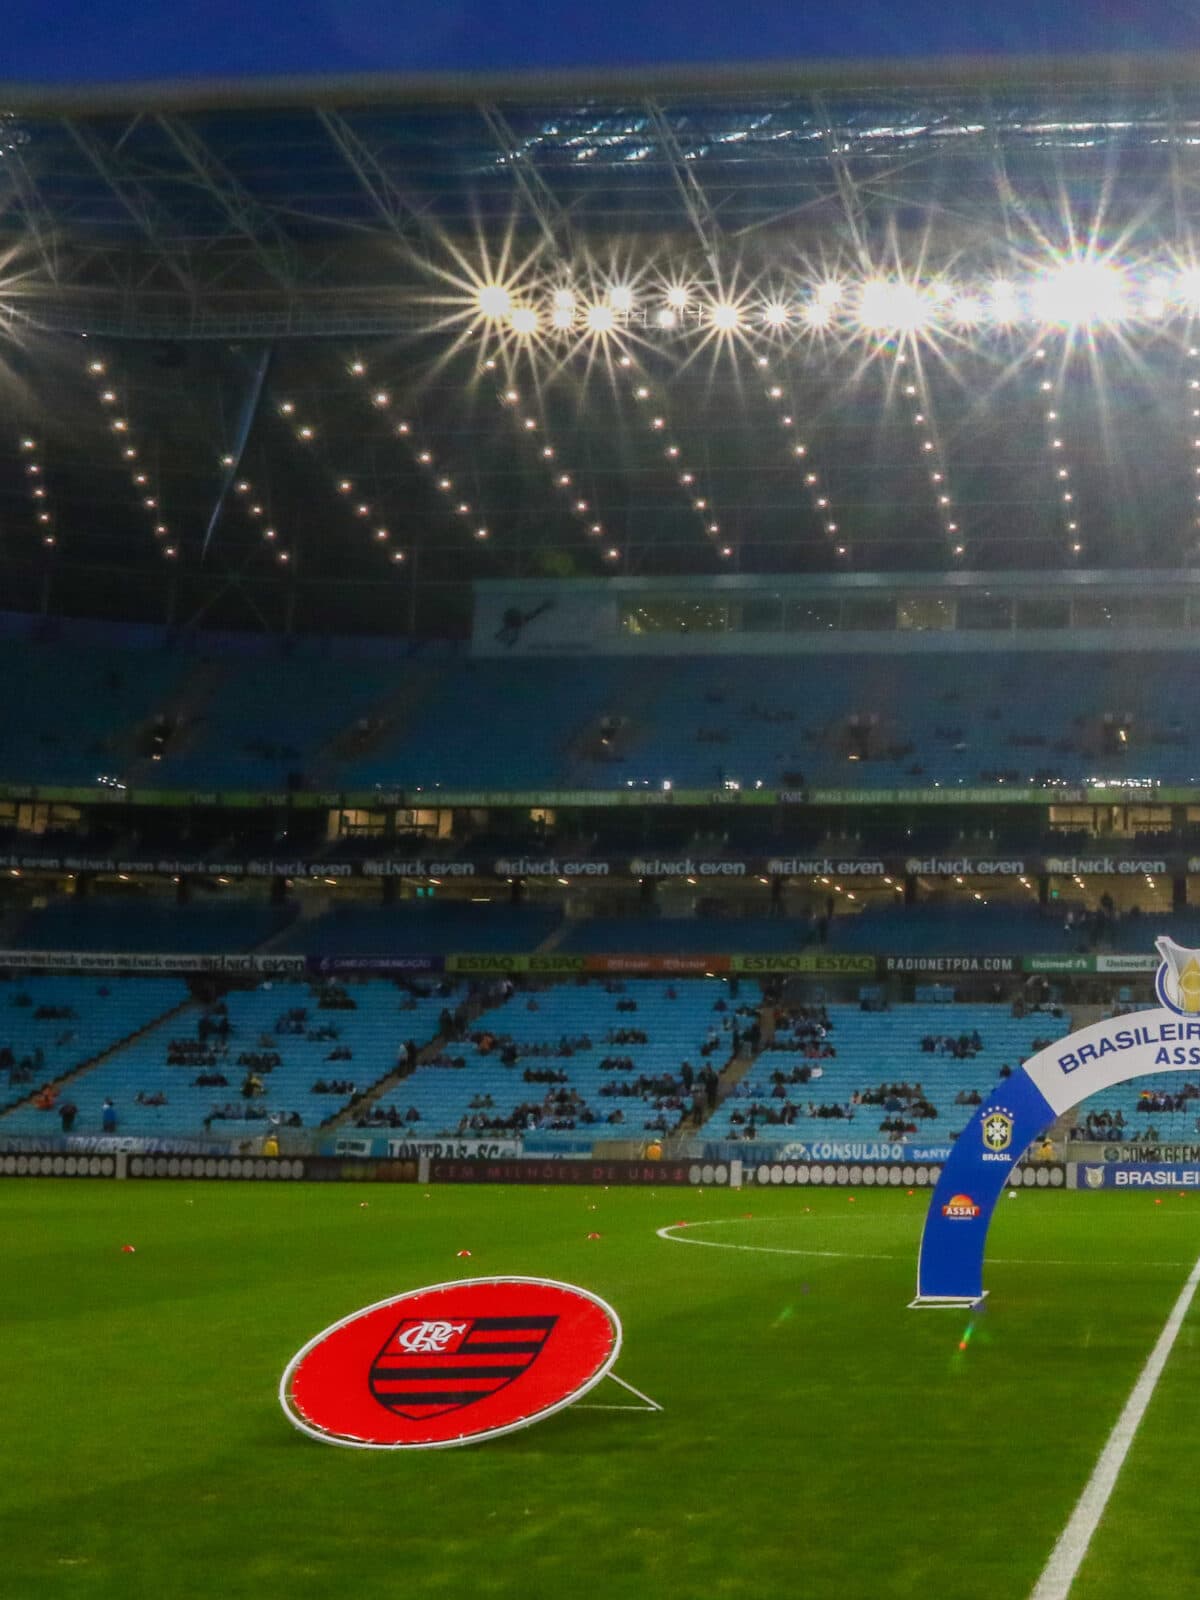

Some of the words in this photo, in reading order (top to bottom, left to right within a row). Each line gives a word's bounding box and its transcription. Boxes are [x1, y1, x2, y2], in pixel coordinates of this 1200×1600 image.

[309, 863, 350, 875] even
[430, 863, 474, 875] even
[563, 862, 609, 875] even
[630, 859, 696, 875] MELNICK
[700, 861, 745, 874] even
[768, 859, 833, 874] MELNICK
[837, 861, 884, 874] even
[905, 857, 972, 873] MELNICK
[977, 861, 1024, 873] even
[1045, 857, 1114, 873] MELNICK
[1118, 860, 1166, 873] even
[812, 1144, 901, 1161] CONSULADO
[982, 1153, 1013, 1162] BRASIL
